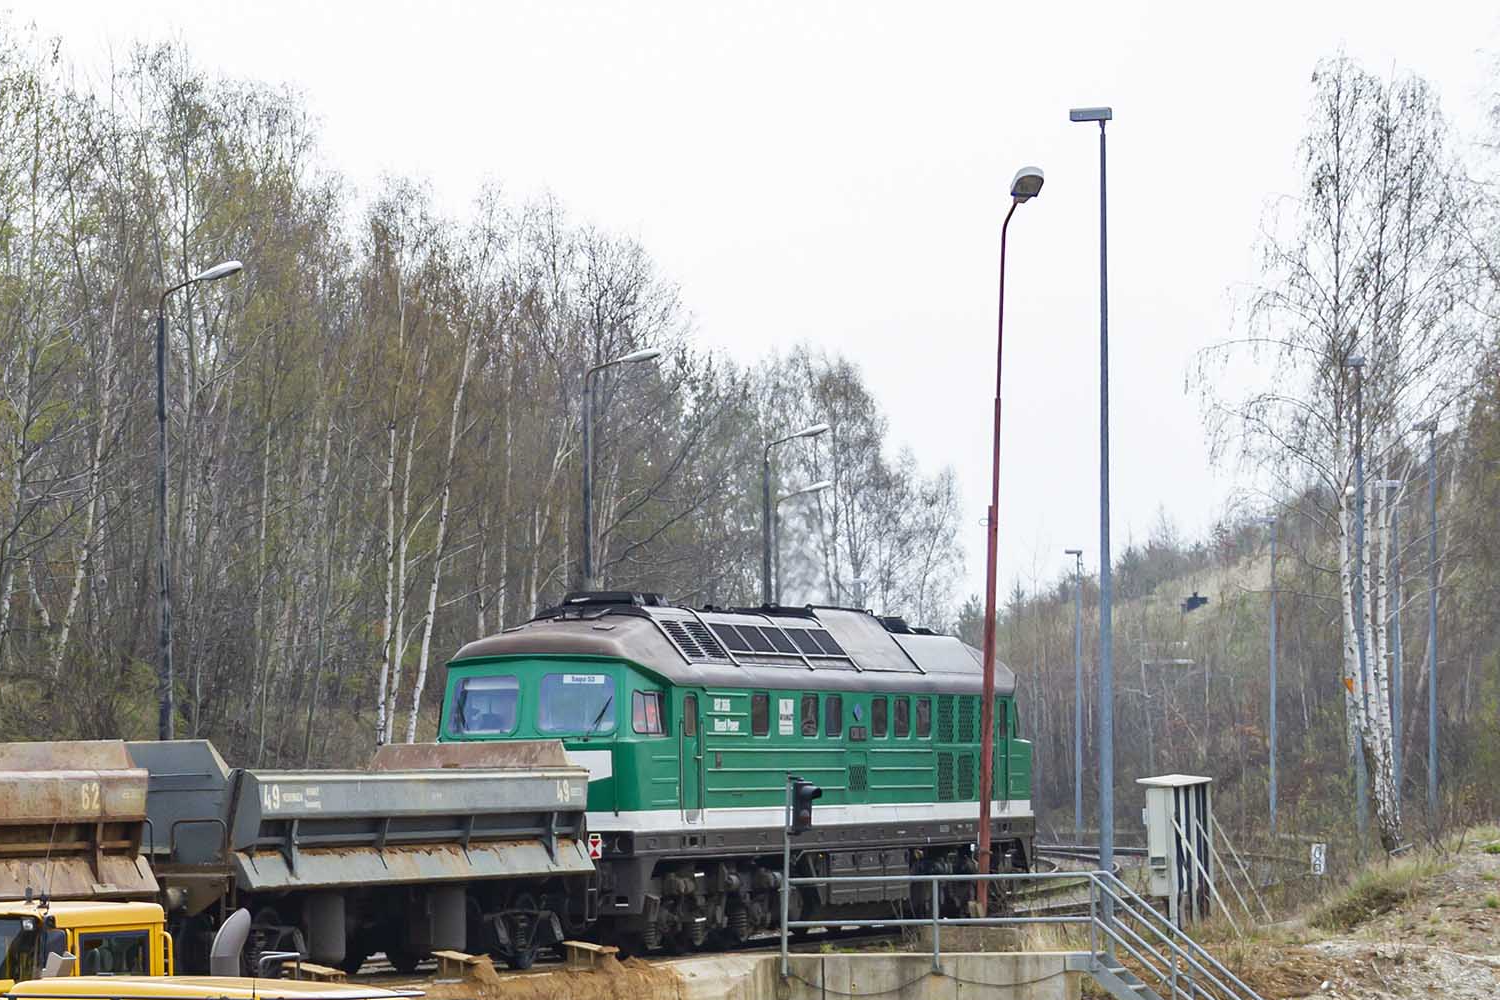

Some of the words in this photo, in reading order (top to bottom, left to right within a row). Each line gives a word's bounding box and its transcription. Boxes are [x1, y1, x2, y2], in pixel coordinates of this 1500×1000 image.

[81, 782, 100, 811] 62
[263, 783, 280, 810] 49
[556, 779, 570, 803] 49
